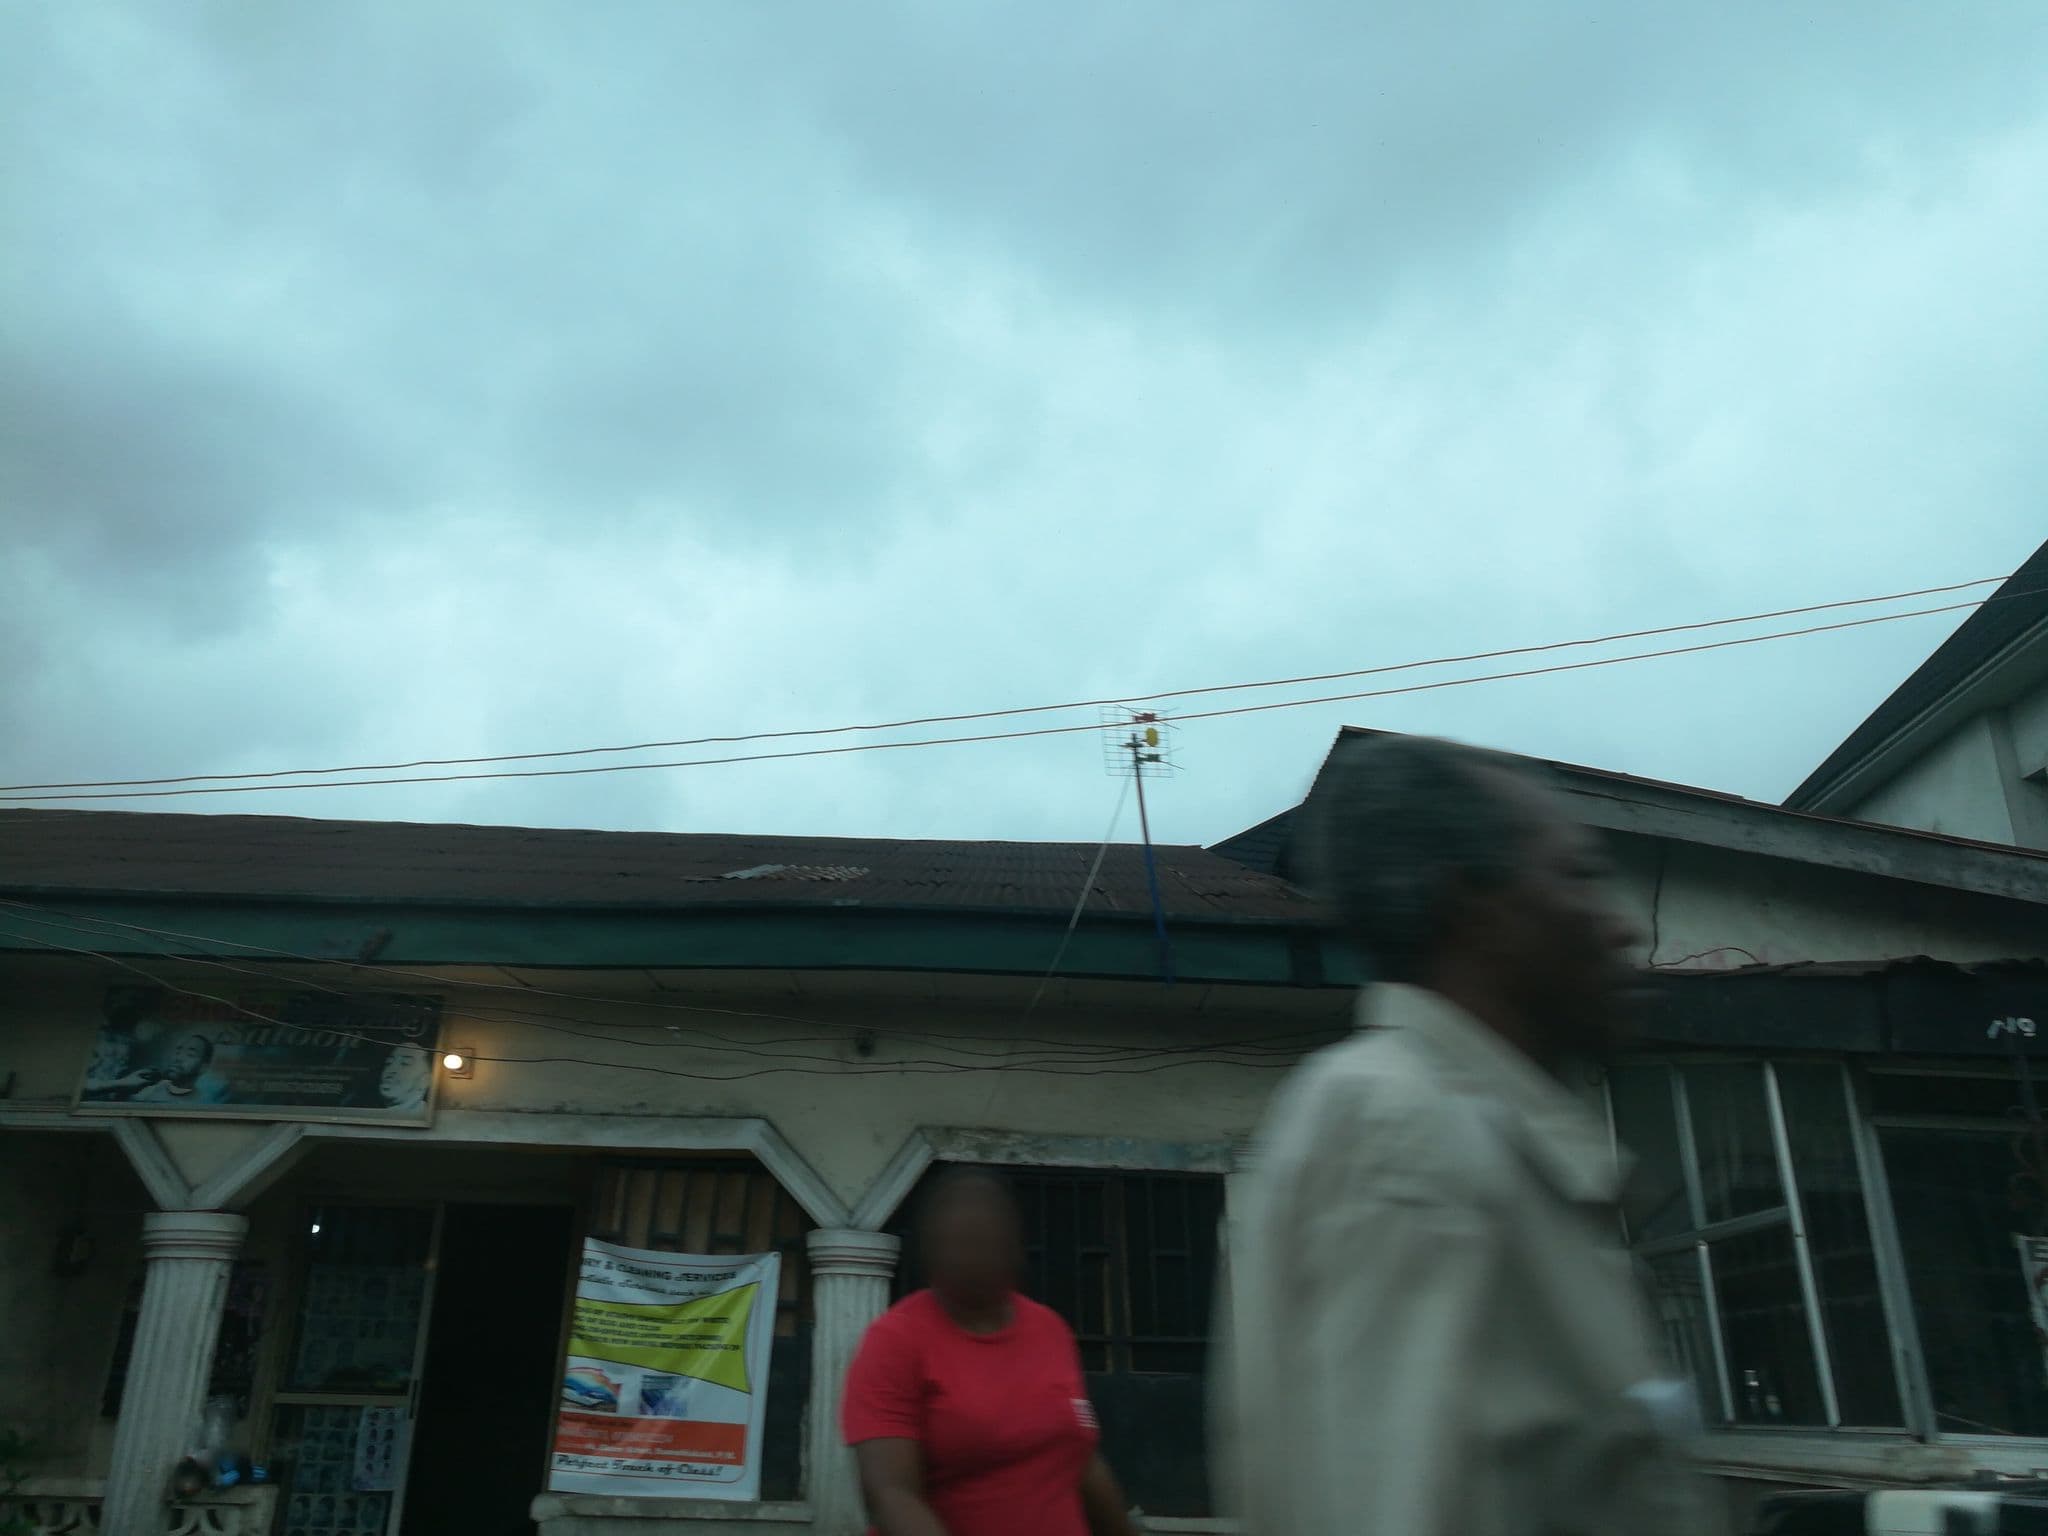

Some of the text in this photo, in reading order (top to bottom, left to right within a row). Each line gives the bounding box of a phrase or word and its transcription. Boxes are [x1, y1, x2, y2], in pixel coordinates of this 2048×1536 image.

[616, 1262, 673, 1281] CLEANING
[674, 1271, 737, 1282] SERVICES
[657, 1465, 676, 1477] of
